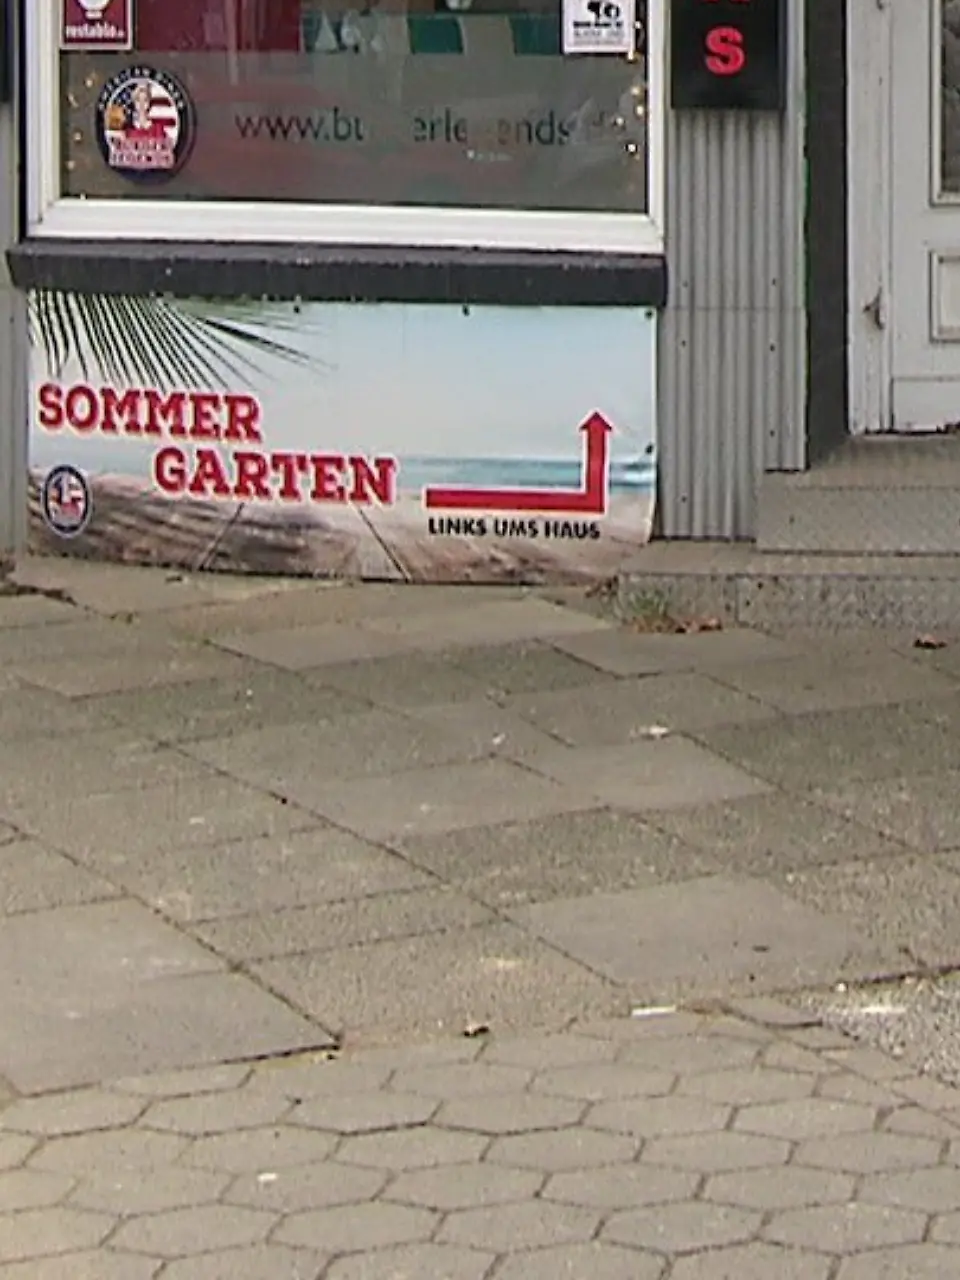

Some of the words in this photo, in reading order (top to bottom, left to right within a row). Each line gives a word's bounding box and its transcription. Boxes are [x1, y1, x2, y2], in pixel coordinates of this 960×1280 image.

[37, 382, 262, 444] SOMMER
[154, 447, 396, 505] GARTEN
[428, 517, 487, 536] LINKS
[494, 518, 539, 538] UMS
[543, 519, 601, 540] HAUS
